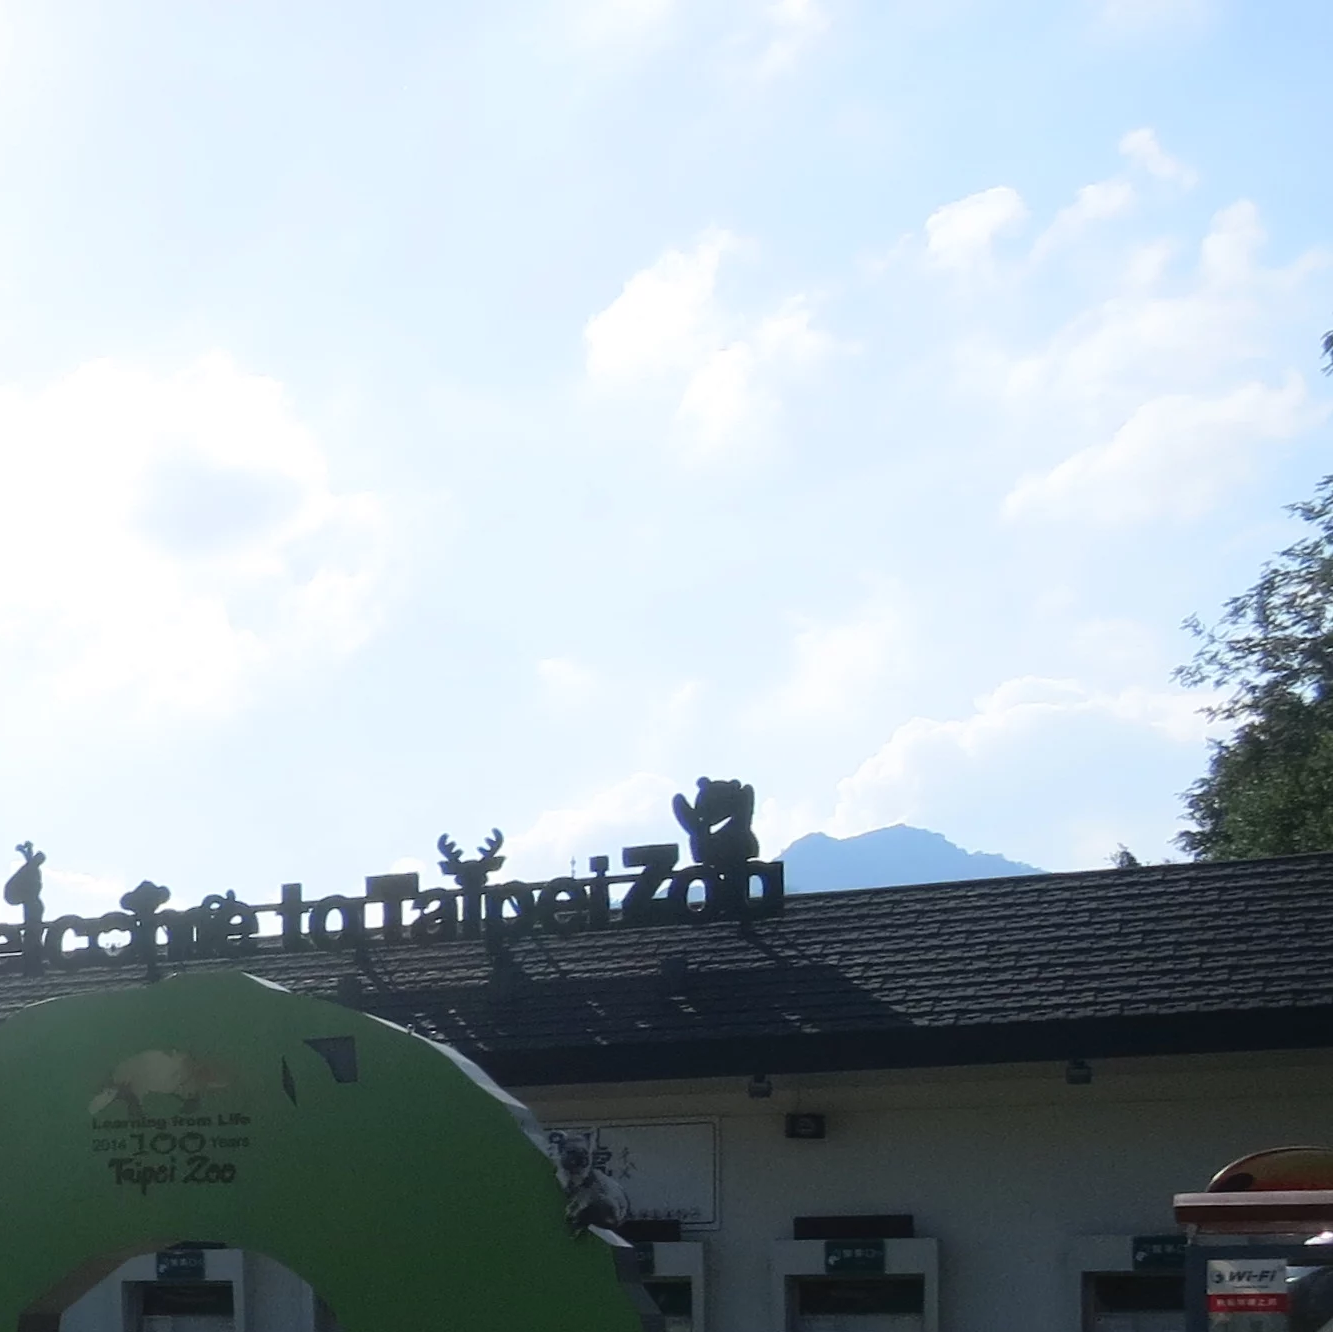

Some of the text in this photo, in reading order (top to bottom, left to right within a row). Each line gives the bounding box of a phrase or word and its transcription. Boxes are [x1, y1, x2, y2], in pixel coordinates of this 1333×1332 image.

[282, 882, 359, 952] to
[366, 856, 610, 950] Taipei
[92, 1117, 167, 1130] Learning
[218, 1112, 251, 1126] Life
[130, 1131, 206, 1156] 100
[211, 1135, 250, 1149] Years
[108, 1154, 237, 1196] Taipei Zoo
[1229, 1270, 1277, 1282] Wi-Fi
